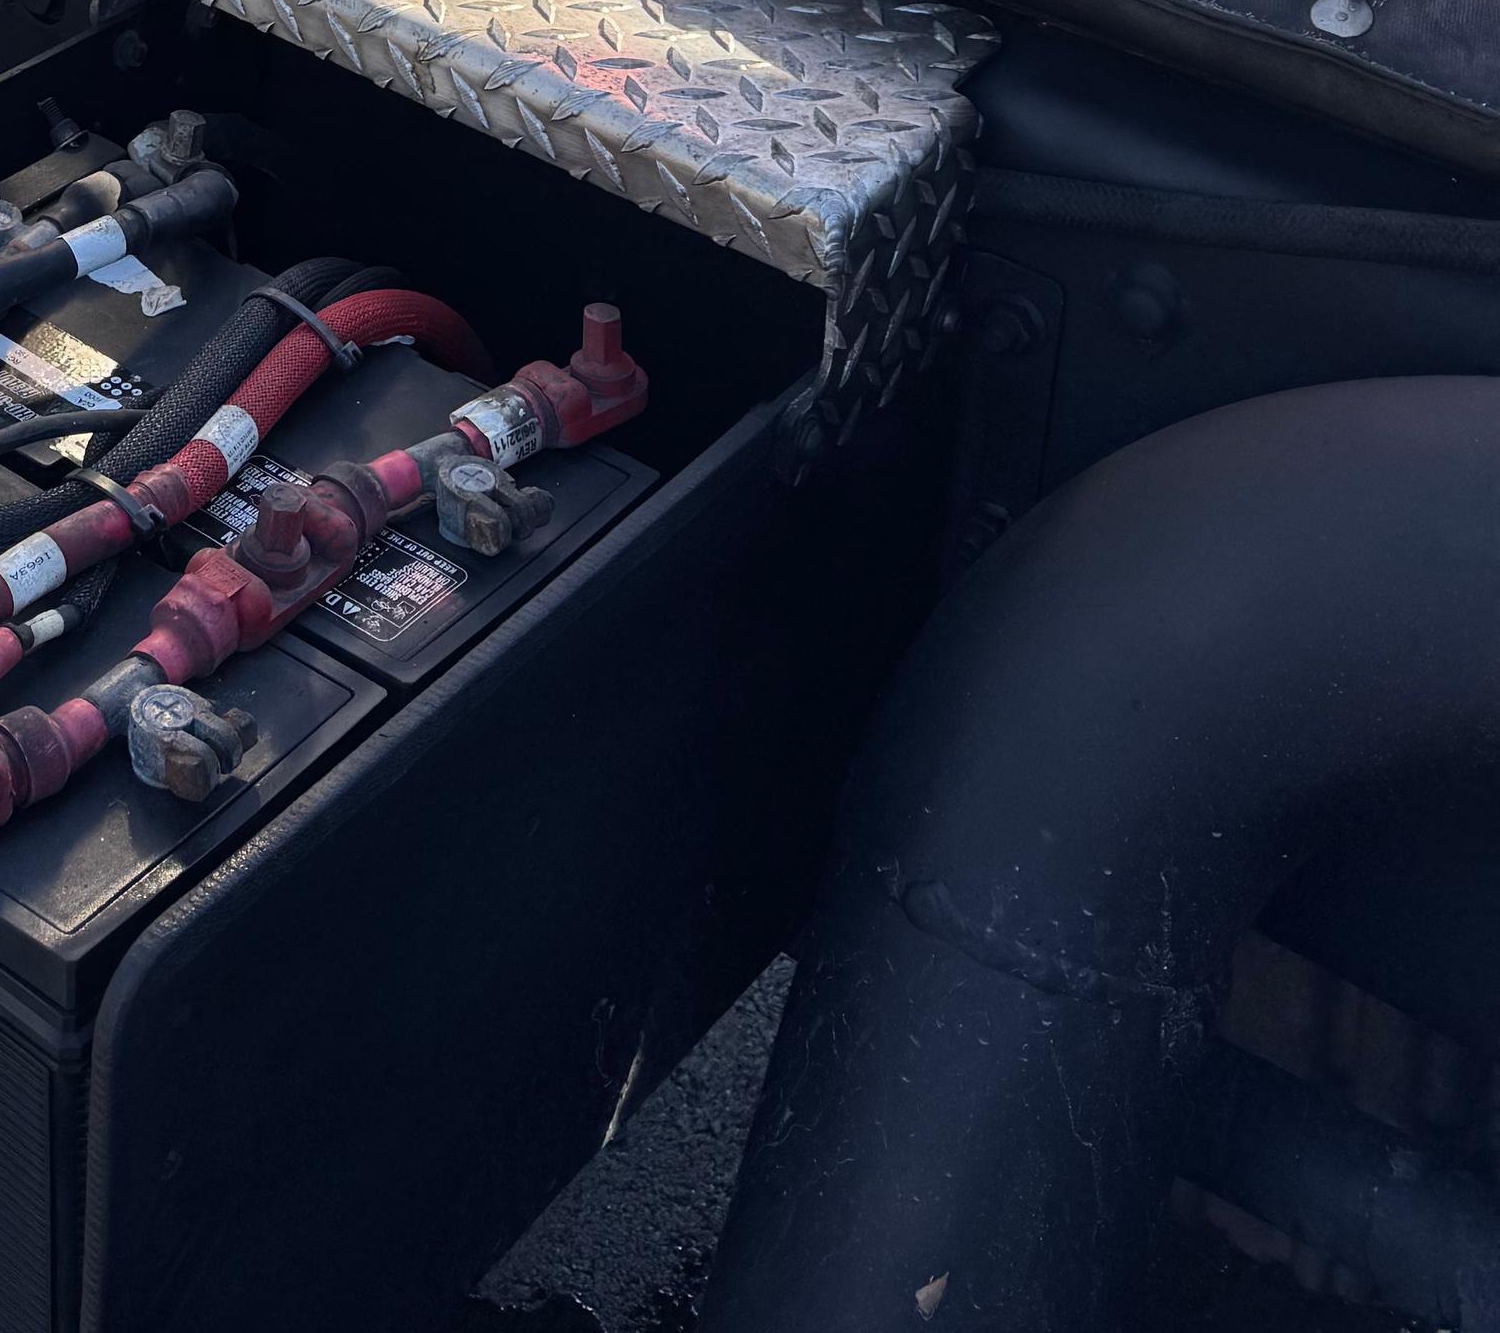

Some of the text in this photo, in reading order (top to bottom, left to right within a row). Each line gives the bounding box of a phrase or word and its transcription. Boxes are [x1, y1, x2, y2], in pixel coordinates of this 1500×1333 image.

[493, 421, 537, 454] 06/22/11
[515, 436, 538, 459] REV.
[243, 465, 261, 477] FAST
[262, 461, 278, 471] TIP.
[278, 470, 295, 481] NOT
[236, 481, 252, 491] GET
[237, 471, 266, 490] MEDICAL
[220, 490, 246, 507] WATER
[206, 504, 247, 530] FLUSH EYES
[386, 531, 457, 574] KEEP OUT OF THE
[387, 568, 434, 597] CAN CAUSE
[400, 564, 442, 592] BLINDNESS
[409, 559, 450, 585] OR INJURY
[356, 572, 401, 600] SHIELD EYES
[368, 568, 427, 605] EXPLOSIVE GASES
